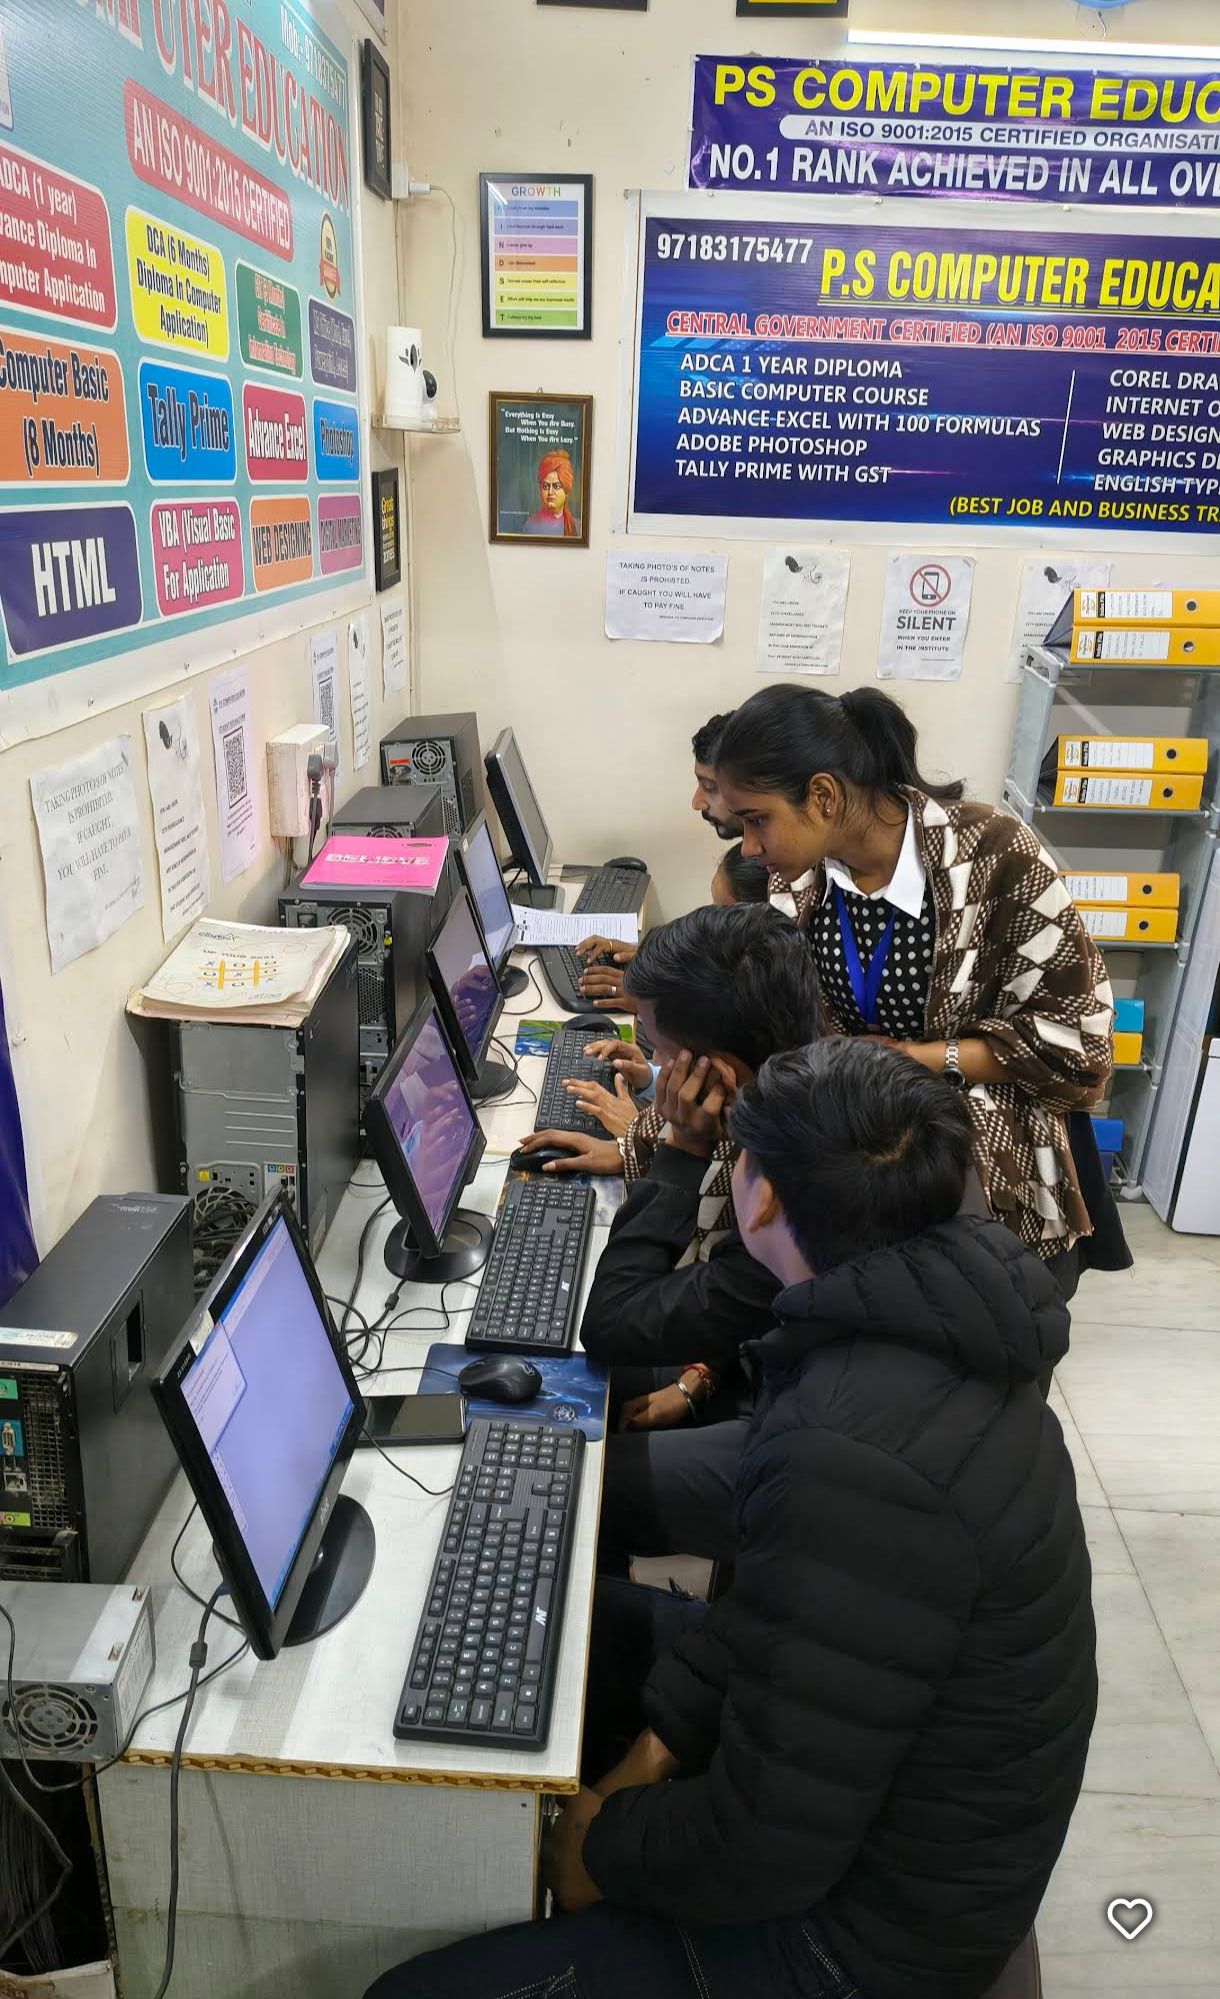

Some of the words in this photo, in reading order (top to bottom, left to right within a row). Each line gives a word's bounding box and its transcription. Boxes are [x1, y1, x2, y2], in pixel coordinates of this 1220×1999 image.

[714, 64, 776, 107] PS
[793, 68, 1074, 118] COMPUTER
[236, 16, 350, 216] EDUCATION
[805, 120, 833, 136] AN
[840, 121, 874, 138] ISO
[881, 124, 972, 141] 9001:2015
[980, 127, 1086, 146] CERTIFIED
[134, 98, 155, 170] AN
[157, 114, 182, 186] ISO
[184, 133, 241, 222] 9001:2015
[242, 173, 291, 250] CERTIFIED
[511, 186, 561, 197] GROWTH
[709, 144, 779, 181] NO.1
[791, 147, 879, 185] RANK
[887, 150, 1050, 191] ACHIEVED
[1060, 158, 1093, 193] IN
[1099, 160, 1158, 196] ALL
[33, 171, 44, 209] (1
[47, 185, 77, 225] year)
[37, 219, 84, 264] Diploma
[85, 239, 97, 269] In
[147, 224, 166, 258] DCA
[167, 234, 177, 265] (6
[178, 239, 210, 282] Months)
[657, 233, 813, 263] 97183175477
[44, 268, 105, 312] Application
[136, 258, 174, 296] Diploma
[175, 273, 184, 300] In
[185, 278, 222, 314] Computer
[820, 248, 876, 299] P.S
[888, 251, 1090, 307] COMPUTER
[160, 304, 208, 349] Application)
[667, 310, 751, 336] CENTRAL
[755, 314, 887, 342] GOVERNMENT
[889, 320, 981, 347] CERTIFIED
[986, 322, 1022, 348] (AN
[1026, 324, 1059, 348] ISO
[1061, 326, 1107, 350] 9001
[1115, 327, 1163, 351] 2015
[70, 351, 109, 402] Basic
[680, 353, 736, 372] ADCA
[741, 356, 752, 373] 1
[759, 357, 808, 375] YEAR
[814, 359, 903, 378] DIPLOMA
[1110, 370, 1171, 389] COREL
[680, 381, 736, 399] BASIC
[741, 383, 846, 403] COMPUTER
[852, 387, 929, 406] COURSE
[1106, 396, 1204, 417] INTERNET
[147, 382, 187, 462] Tally
[188, 389, 229, 452] Prime
[248, 406, 284, 461] Advance
[284, 412, 306, 462] Excel
[678, 408, 770, 427] ADVANCE
[775, 411, 831, 429] EXCEL
[837, 413, 889, 431] WITH
[896, 415, 930, 433] 100
[935, 416, 1041, 436] FORMULAS
[1103, 422, 1145, 441] WEB
[23, 416, 40, 477] (8
[41, 417, 100, 477] Months)
[677, 434, 742, 452] ADOBE
[748, 437, 868, 456] PHOTOSHOP
[1098, 449, 1197, 470] GRAPHICS
[676, 460, 729, 478] TALLY
[735, 462, 793, 480] PRIME
[798, 465, 850, 482] WITH
[854, 467, 893, 483] GST
[1094, 474, 1176, 492] ENGLISH
[158, 509, 180, 549] VBA
[182, 507, 212, 552] (Visual
[213, 507, 235, 542] Basic
[949, 497, 1003, 517] (BEST
[1006, 499, 1044, 517] JOB
[1049, 500, 1094, 518] AND
[1100, 502, 1190, 523] BUSINESS
[252, 524, 272, 567] WEB
[273, 519, 312, 562] DESIGNING
[31, 537, 116, 617] HTML
[163, 563, 180, 601] For
[183, 556, 230, 604] Application
[620, 562, 645, 570] TAKING
[647, 563, 678, 571] PHOTO'S
[680, 564, 688, 572] OF
[628, 589, 656, 597] CAUGHT
[674, 591, 691, 599] WILL
[896, 616, 957, 631] SILENT
